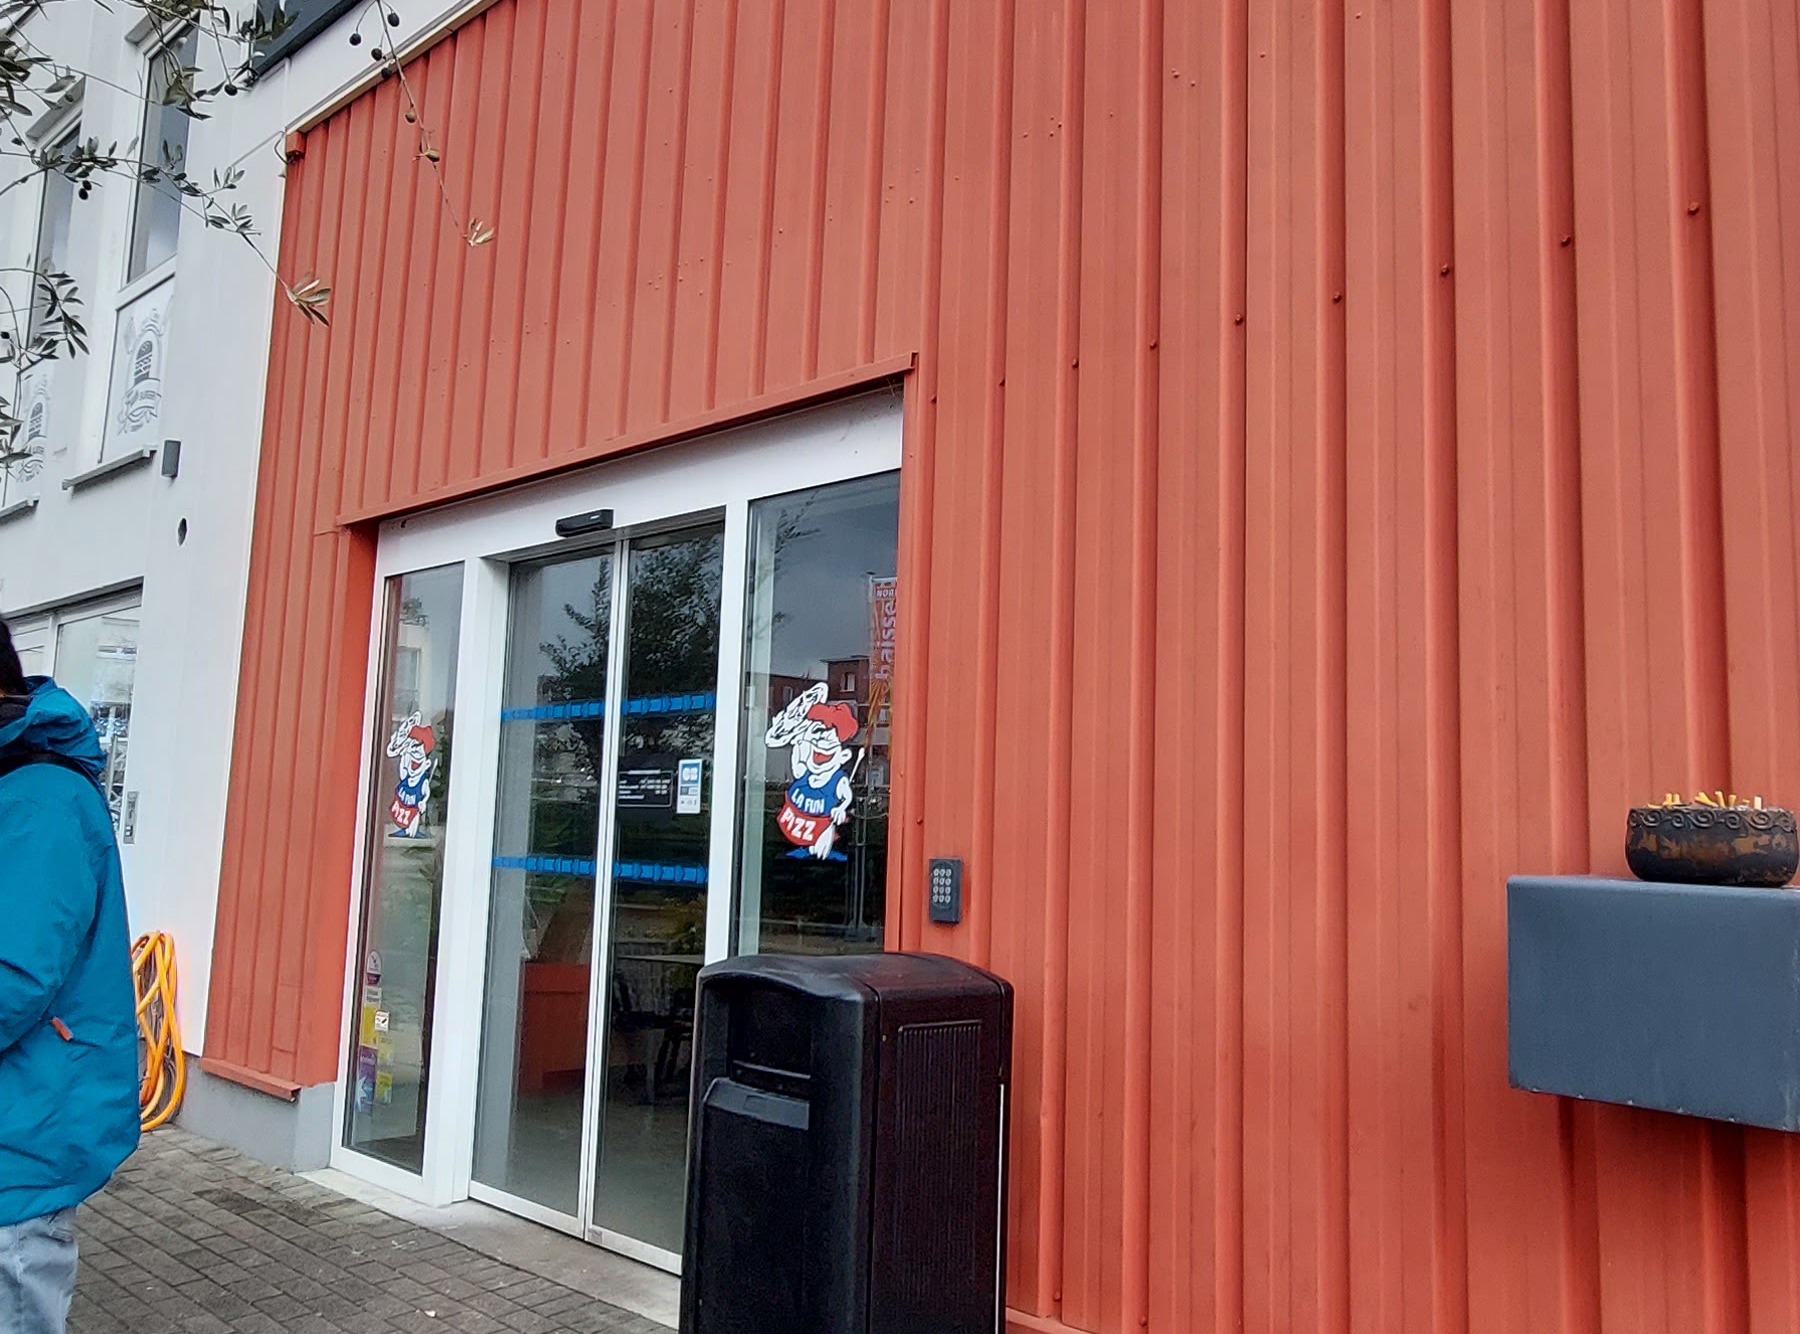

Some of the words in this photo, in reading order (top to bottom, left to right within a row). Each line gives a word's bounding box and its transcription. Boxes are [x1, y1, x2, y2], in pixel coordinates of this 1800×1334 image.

[790, 787, 805, 808] LA
[804, 797, 825, 814] FUN
[780, 806, 816, 841] PIZZ
